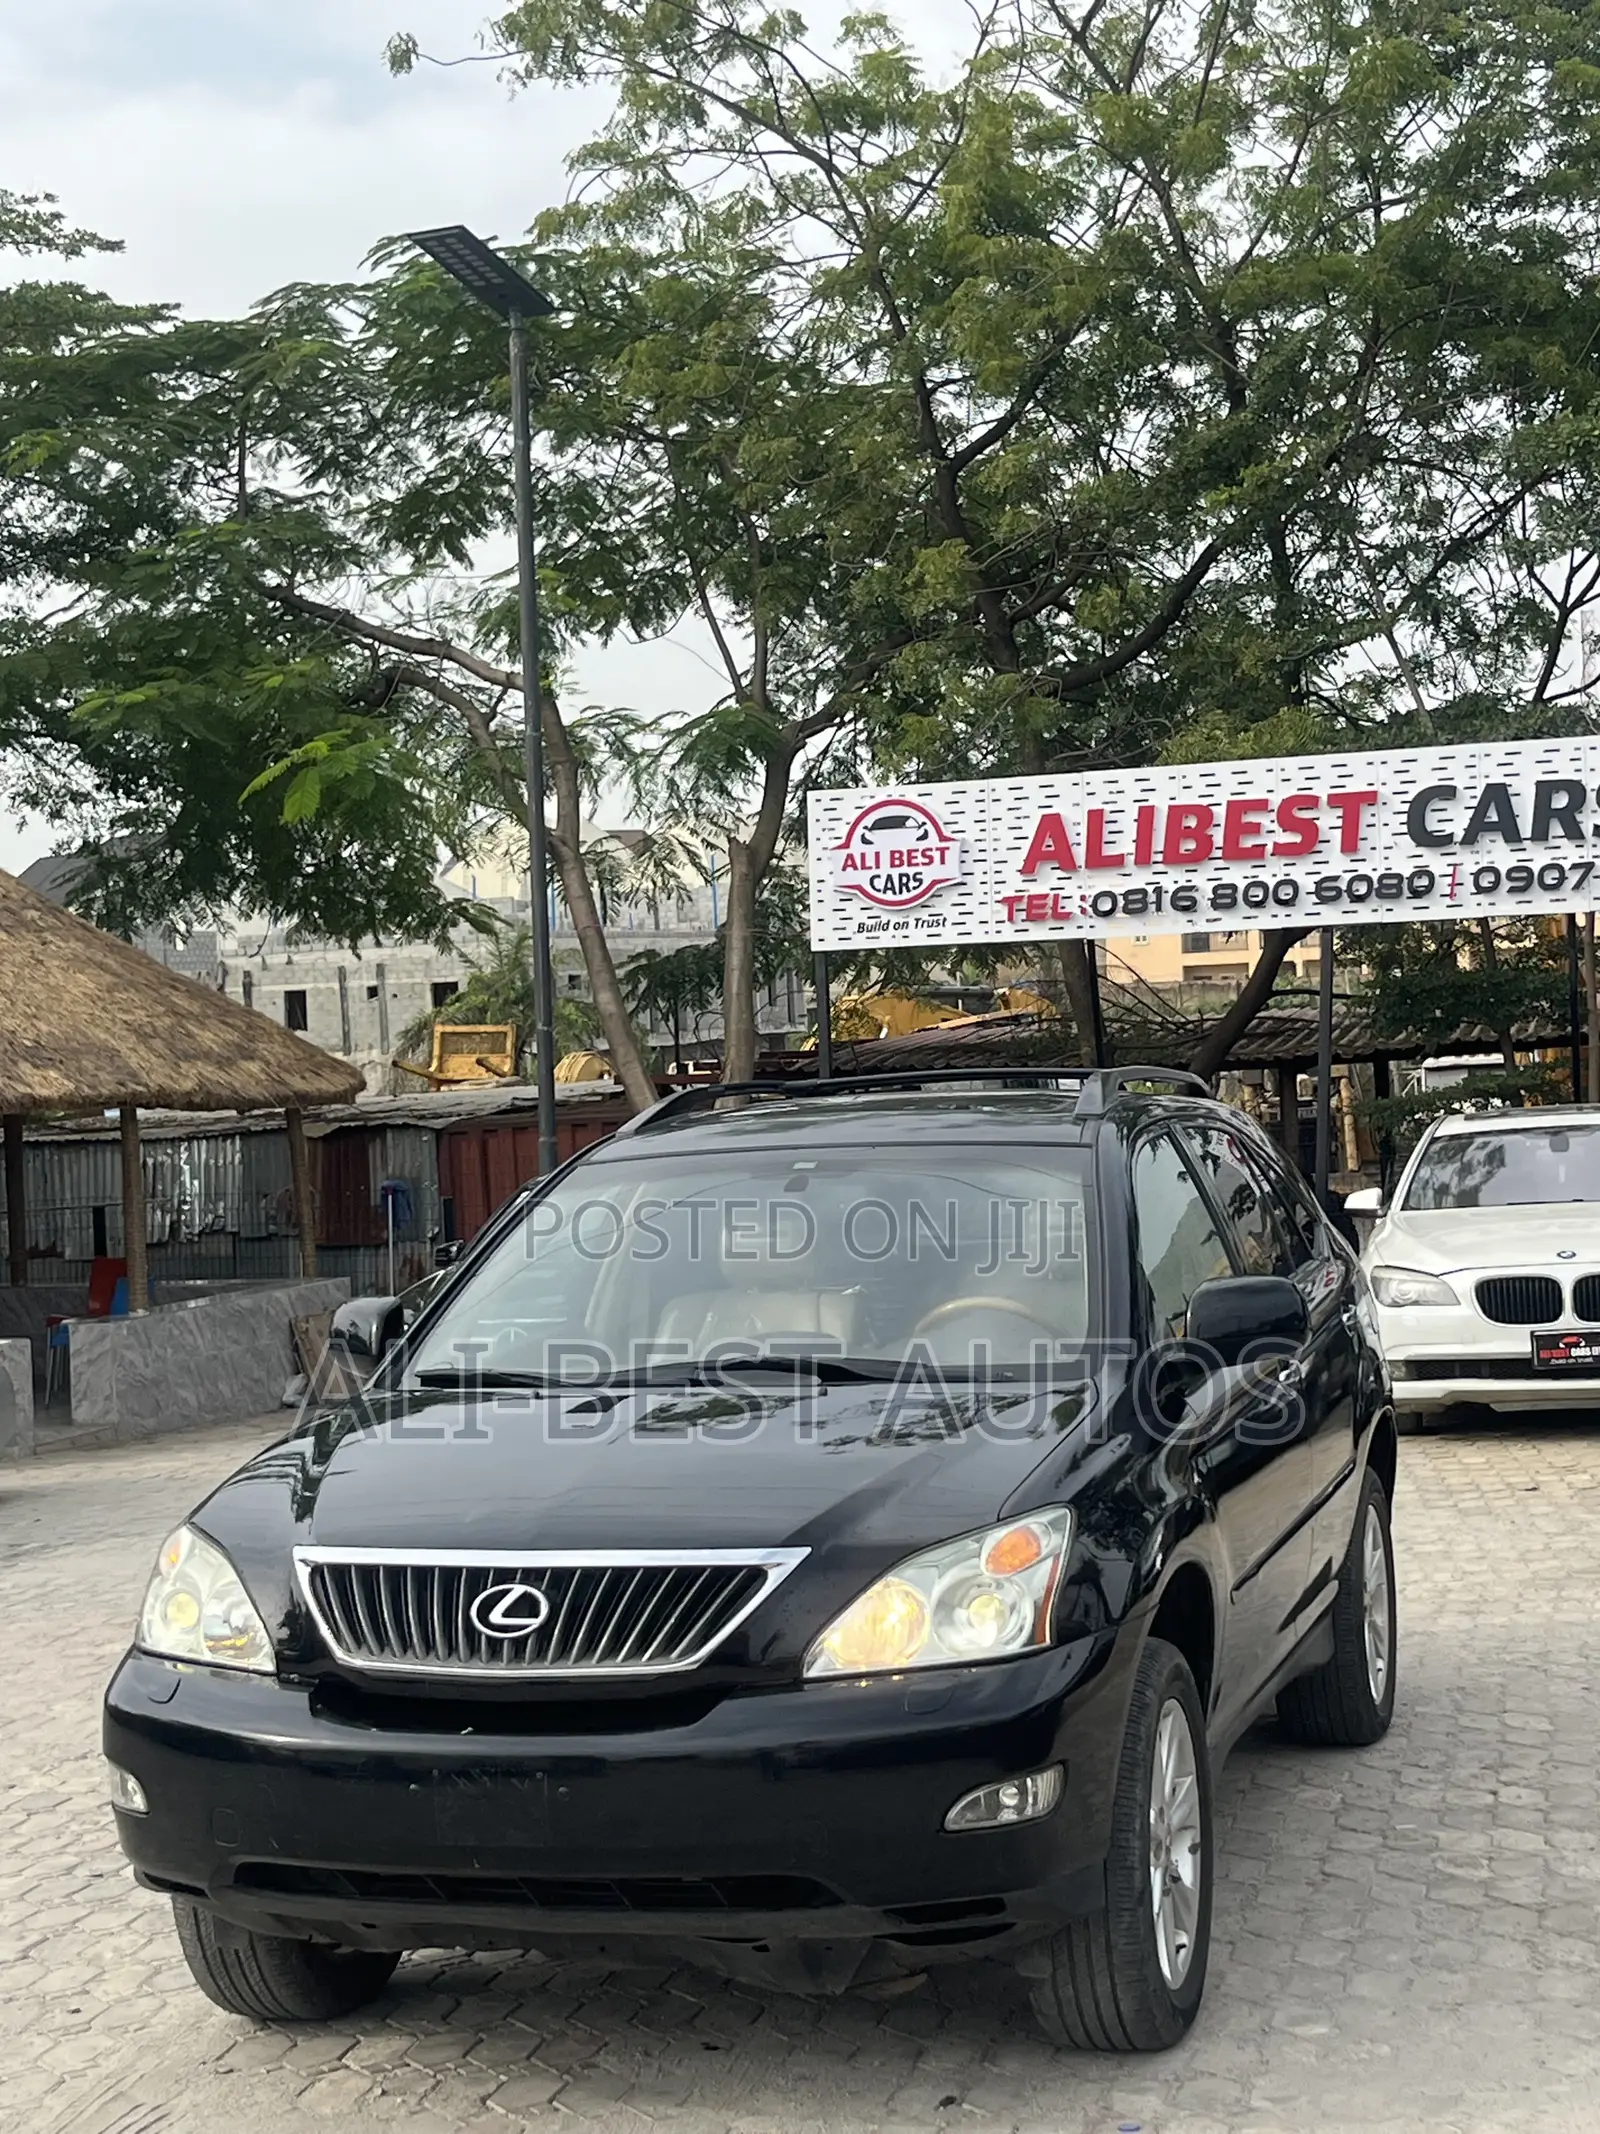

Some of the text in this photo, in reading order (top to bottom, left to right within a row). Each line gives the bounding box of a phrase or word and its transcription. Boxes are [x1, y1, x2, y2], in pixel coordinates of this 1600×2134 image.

[1020, 790, 1378, 875] ALIBEST
[841, 846, 950, 872] ALI BEST
[869, 872, 924, 895] CARS
[1210, 879, 1299, 910] 800
[1314, 869, 1435, 903] 6080
[857, 917, 947, 934] Build on Trust
